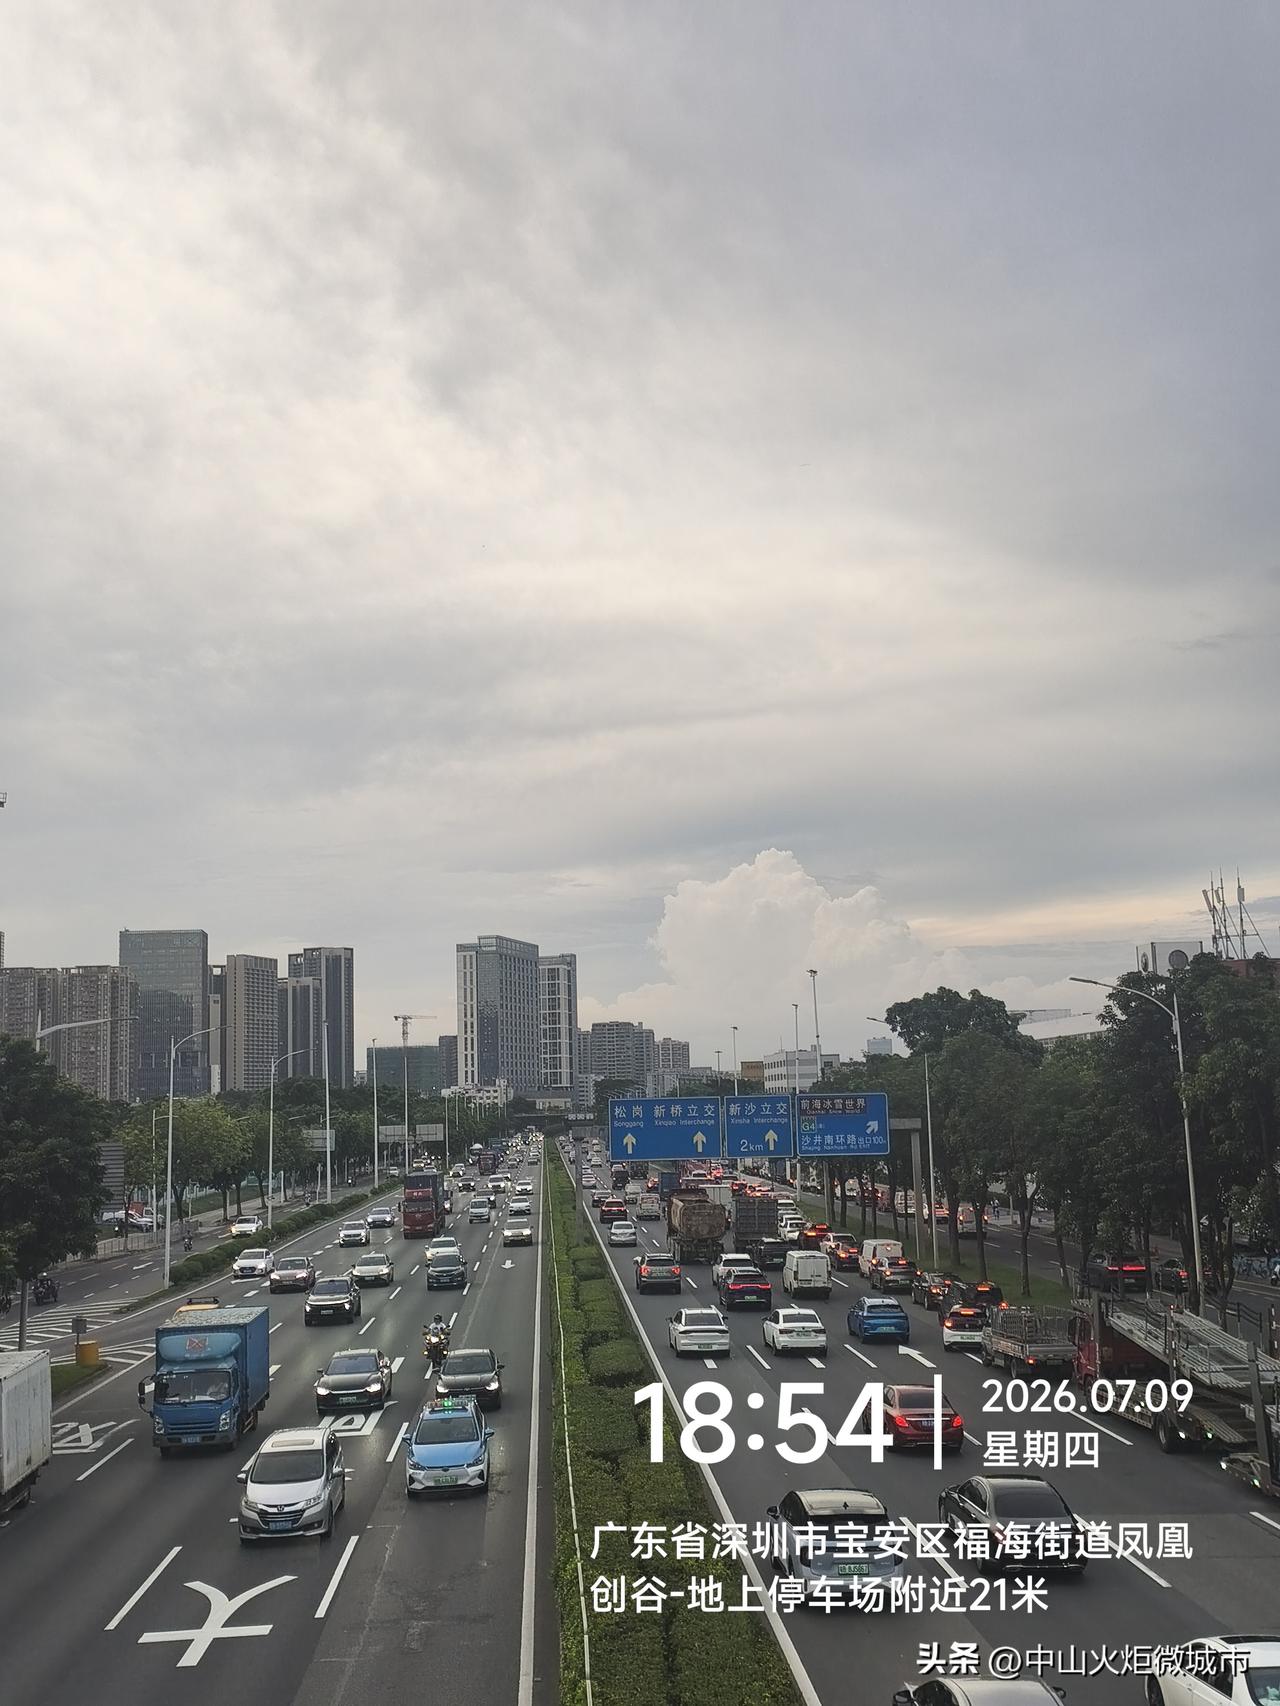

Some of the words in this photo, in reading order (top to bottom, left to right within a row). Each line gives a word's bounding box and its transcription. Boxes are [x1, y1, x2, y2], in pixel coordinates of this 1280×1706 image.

[729, 1102, 788, 1116] 新沙立交
[801, 1098, 866, 1110] 前海冰雪世界
[614, 1105, 643, 1118] 松岗
[653, 1104, 715, 1117] 新桥立交
[680, 1118, 715, 1126] Interchange
[802, 1122, 815, 1131] G4
